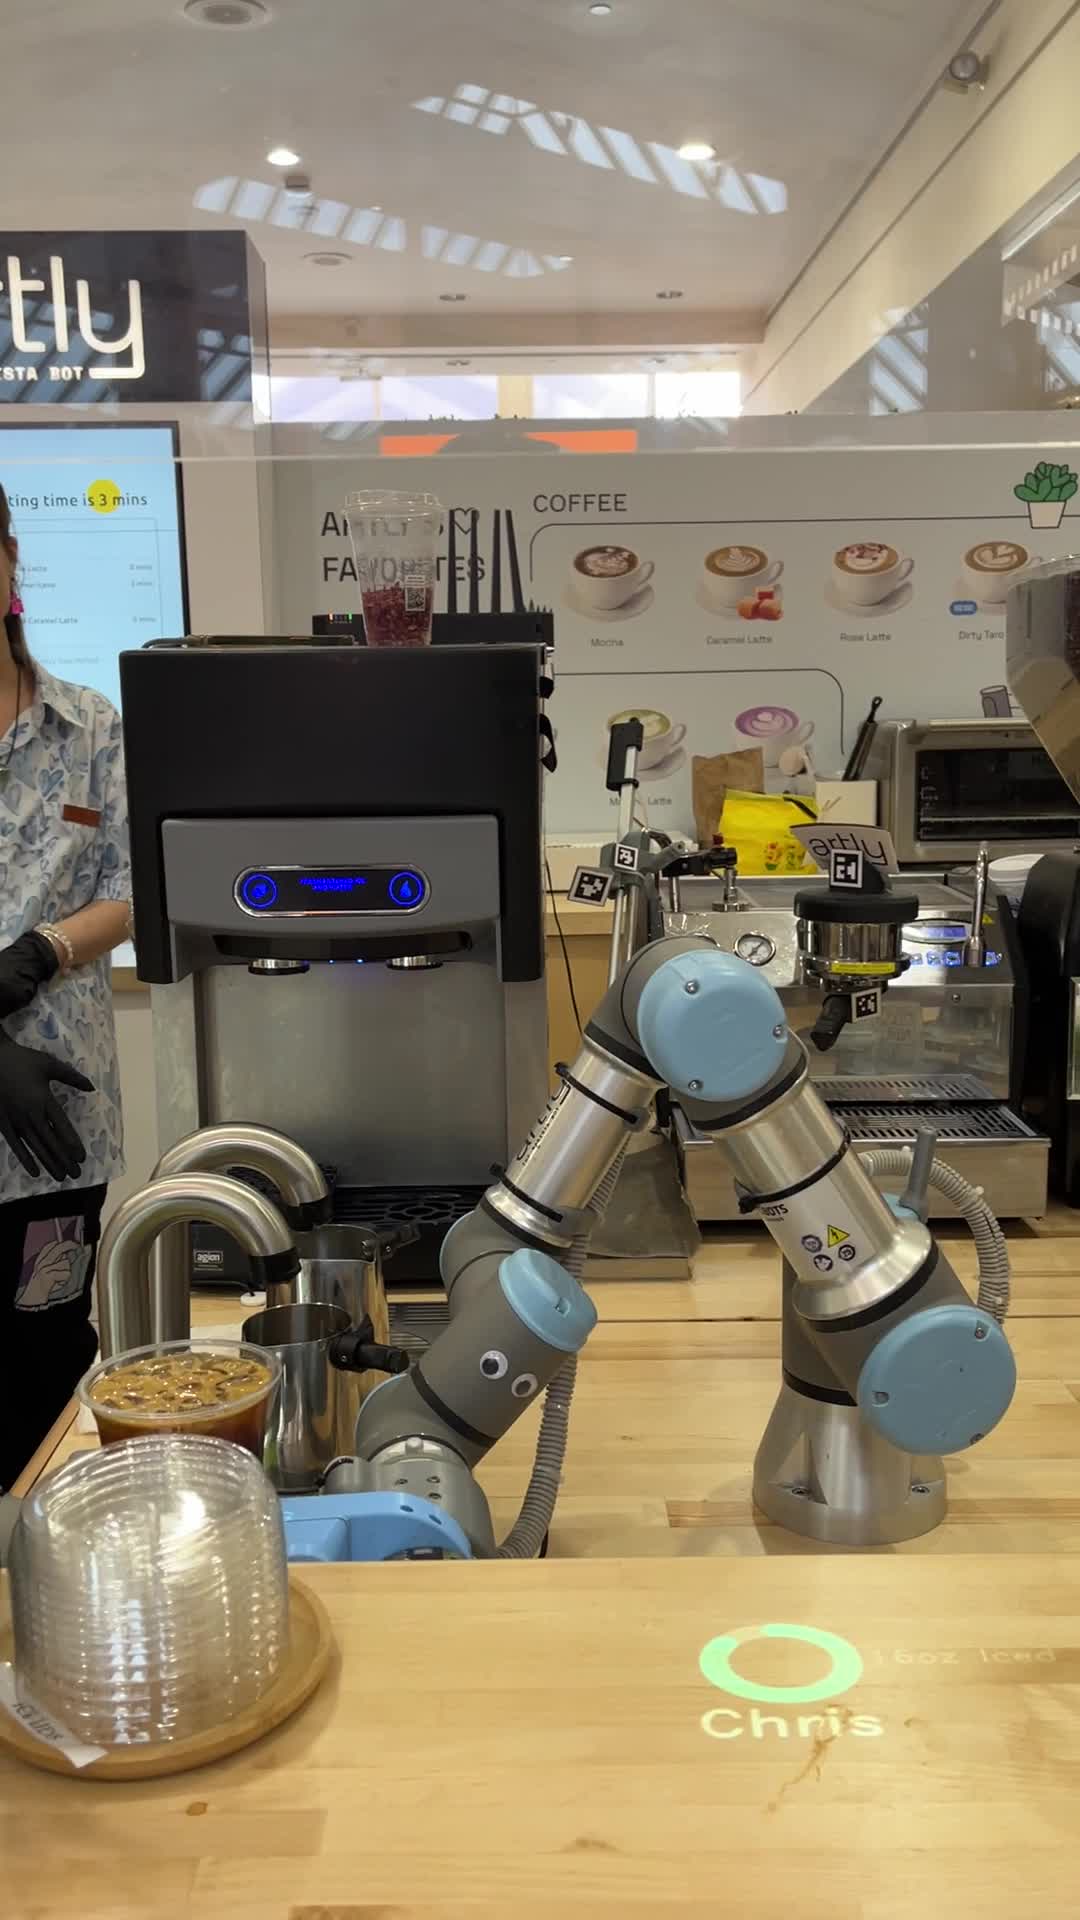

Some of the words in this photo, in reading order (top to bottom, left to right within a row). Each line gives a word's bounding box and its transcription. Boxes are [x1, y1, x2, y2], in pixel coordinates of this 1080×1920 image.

[0, 255, 145, 379] tly
[49, 366, 83, 381] BOT
[43, 493, 78, 507] time
[83, 493, 95, 507] is
[99, 493, 108, 507] 3
[112, 492, 148, 507] mins
[532, 493, 628, 513] COFFEE
[747, 634, 773, 645] Latte
[866, 631, 892, 642] Latte
[958, 630, 982, 642] Dirty
[809, 831, 889, 867] artly
[700, 1706, 886, 1739] Chris
